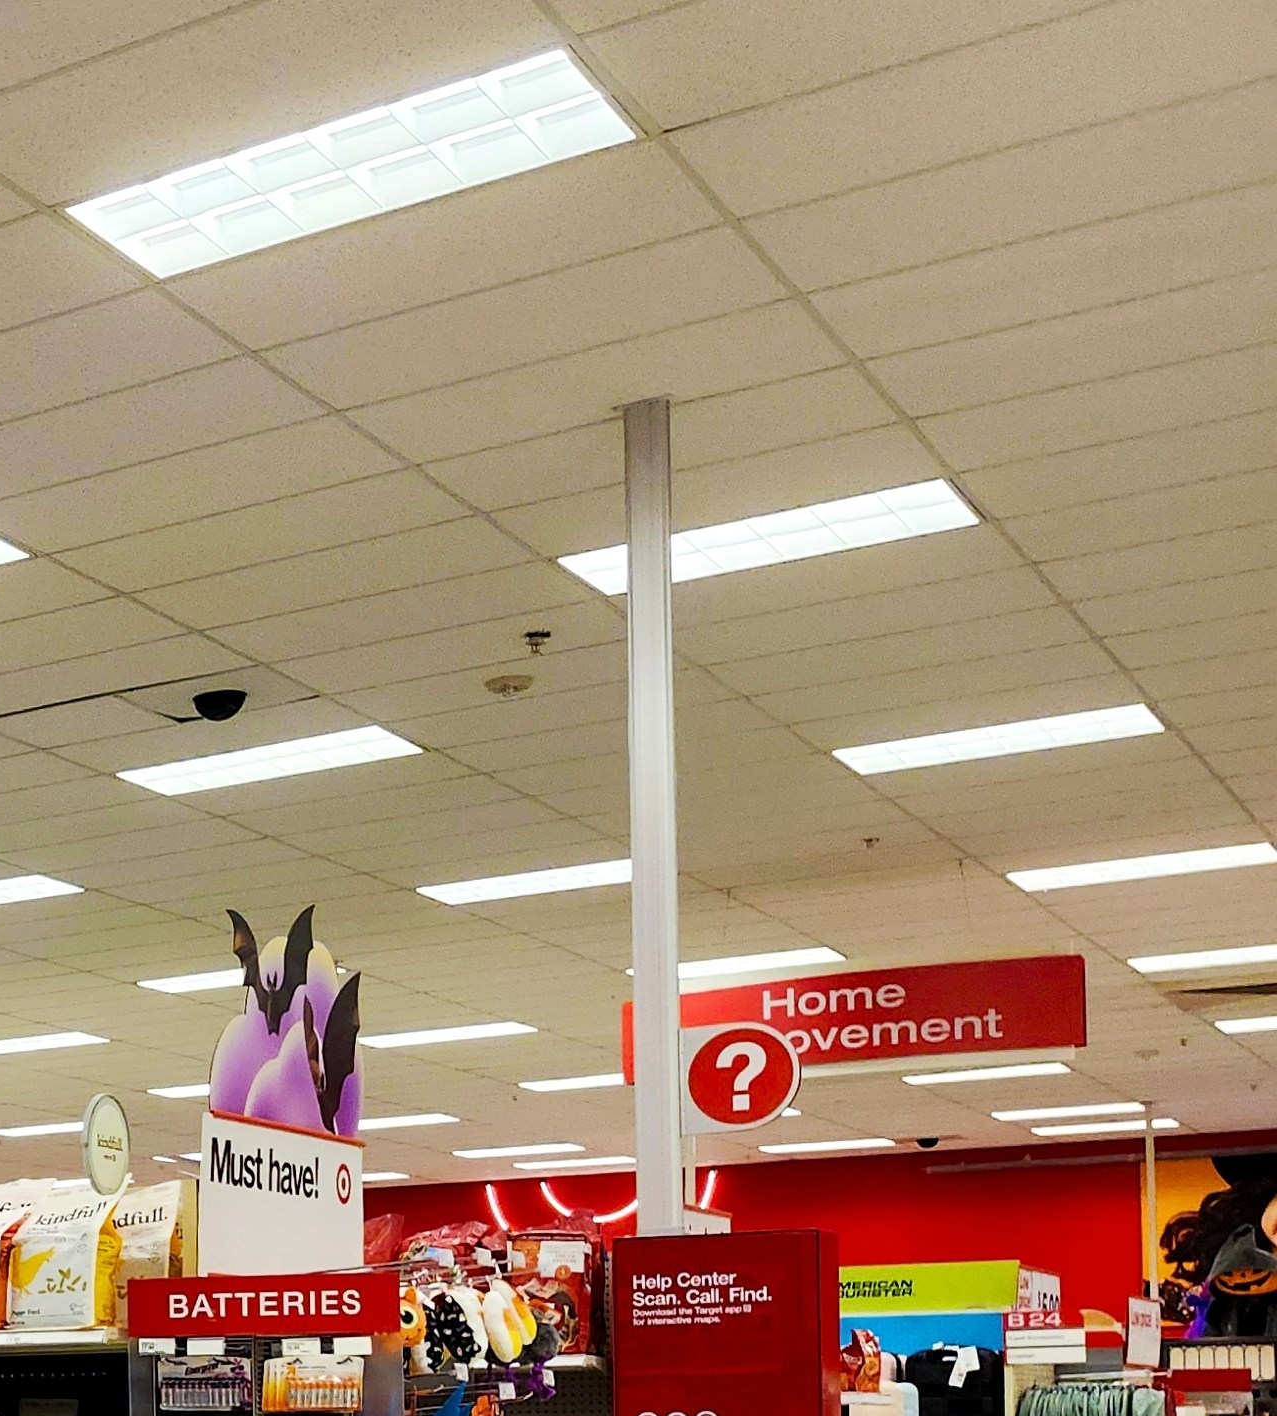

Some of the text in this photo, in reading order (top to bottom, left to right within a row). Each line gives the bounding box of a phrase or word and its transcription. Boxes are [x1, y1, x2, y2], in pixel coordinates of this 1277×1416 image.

[762, 982, 905, 1020] Home
[787, 1008, 1003, 1054] ovement
[209, 1137, 320, 1199] Must have!
[632, 1272, 737, 1291] Help Center
[838, 1280, 913, 1289] MERICAN
[168, 1290, 361, 1319] BATTERIES
[632, 1286, 772, 1307] Scan. Call. Find.
[633, 1305, 742, 1317] Download the Target app
[633, 1315, 721, 1326] for interactive maps.
[1008, 1313, 1061, 1327] B 24
